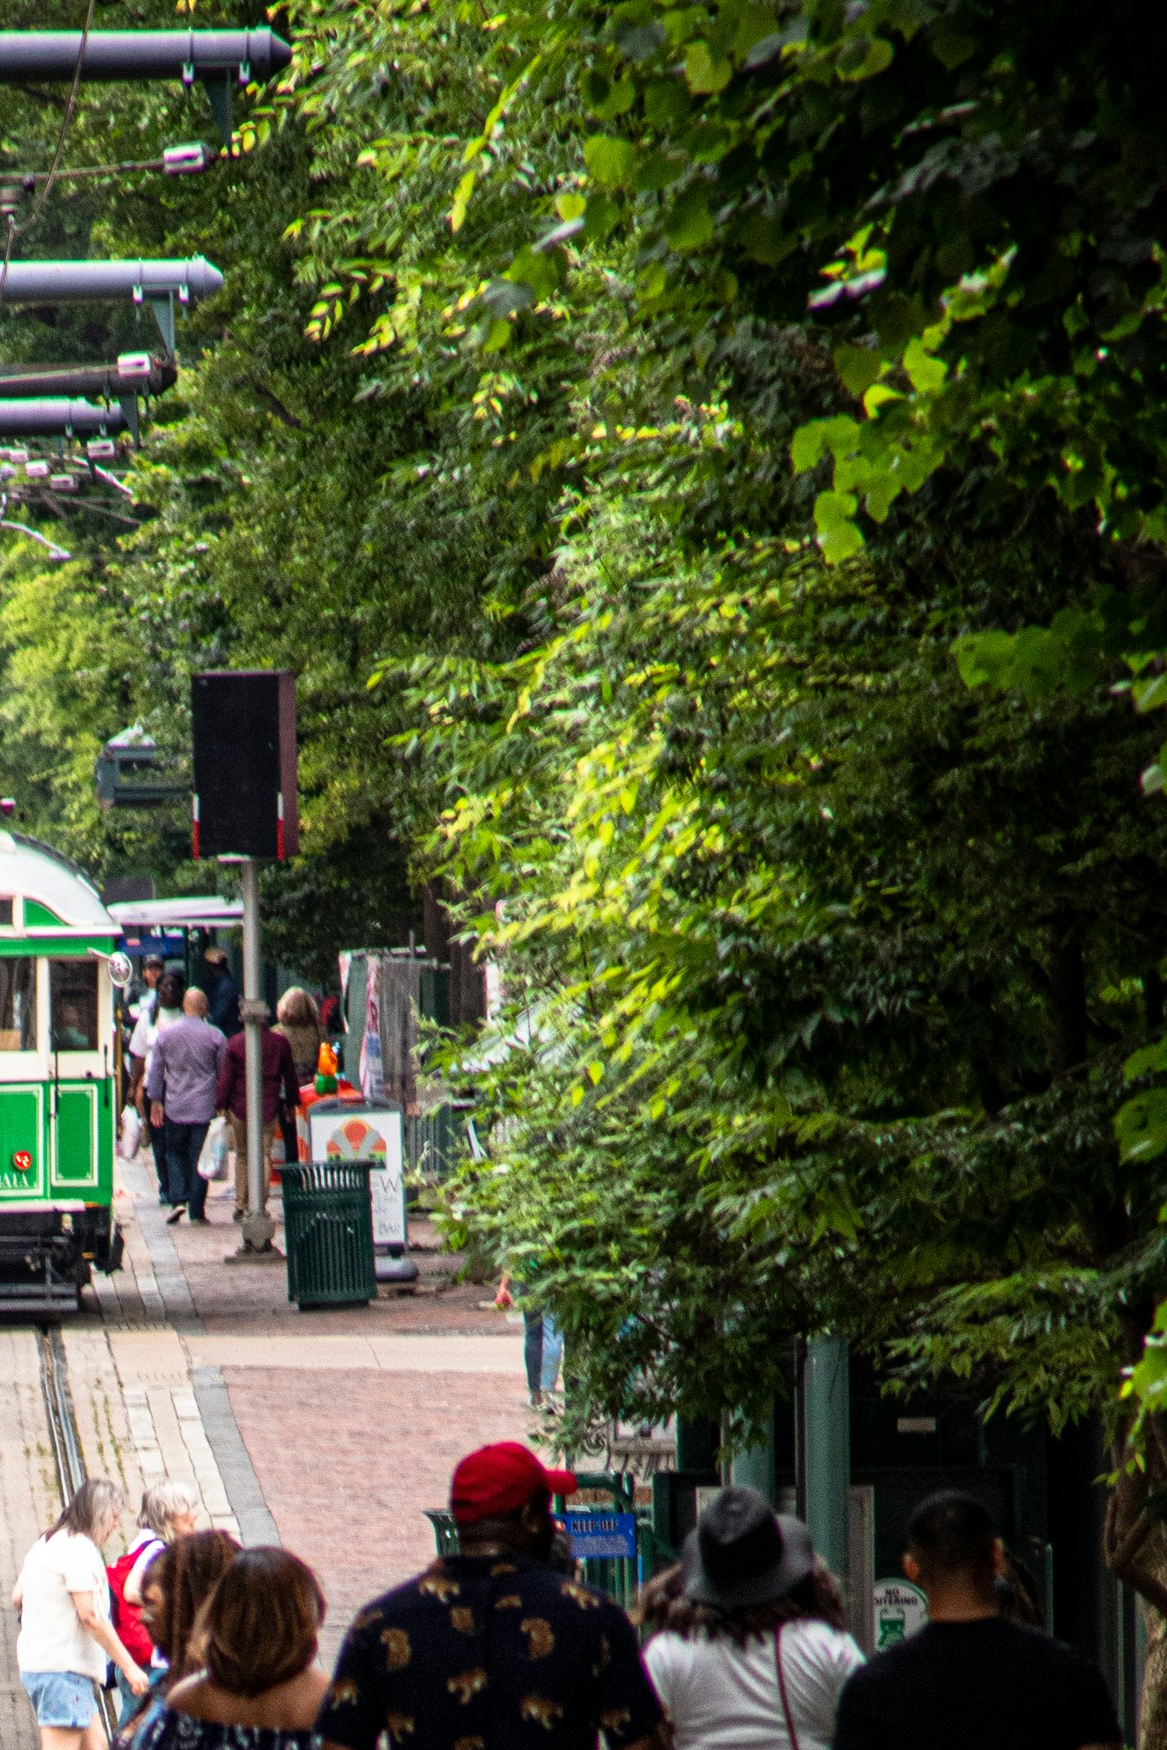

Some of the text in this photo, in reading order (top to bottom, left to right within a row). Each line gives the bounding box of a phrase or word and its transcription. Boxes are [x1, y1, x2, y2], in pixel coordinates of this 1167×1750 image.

[571, 1519, 597, 1534] KEEP
[885, 1588, 900, 1598] NO
[874, 1596, 918, 1606] OITERING
